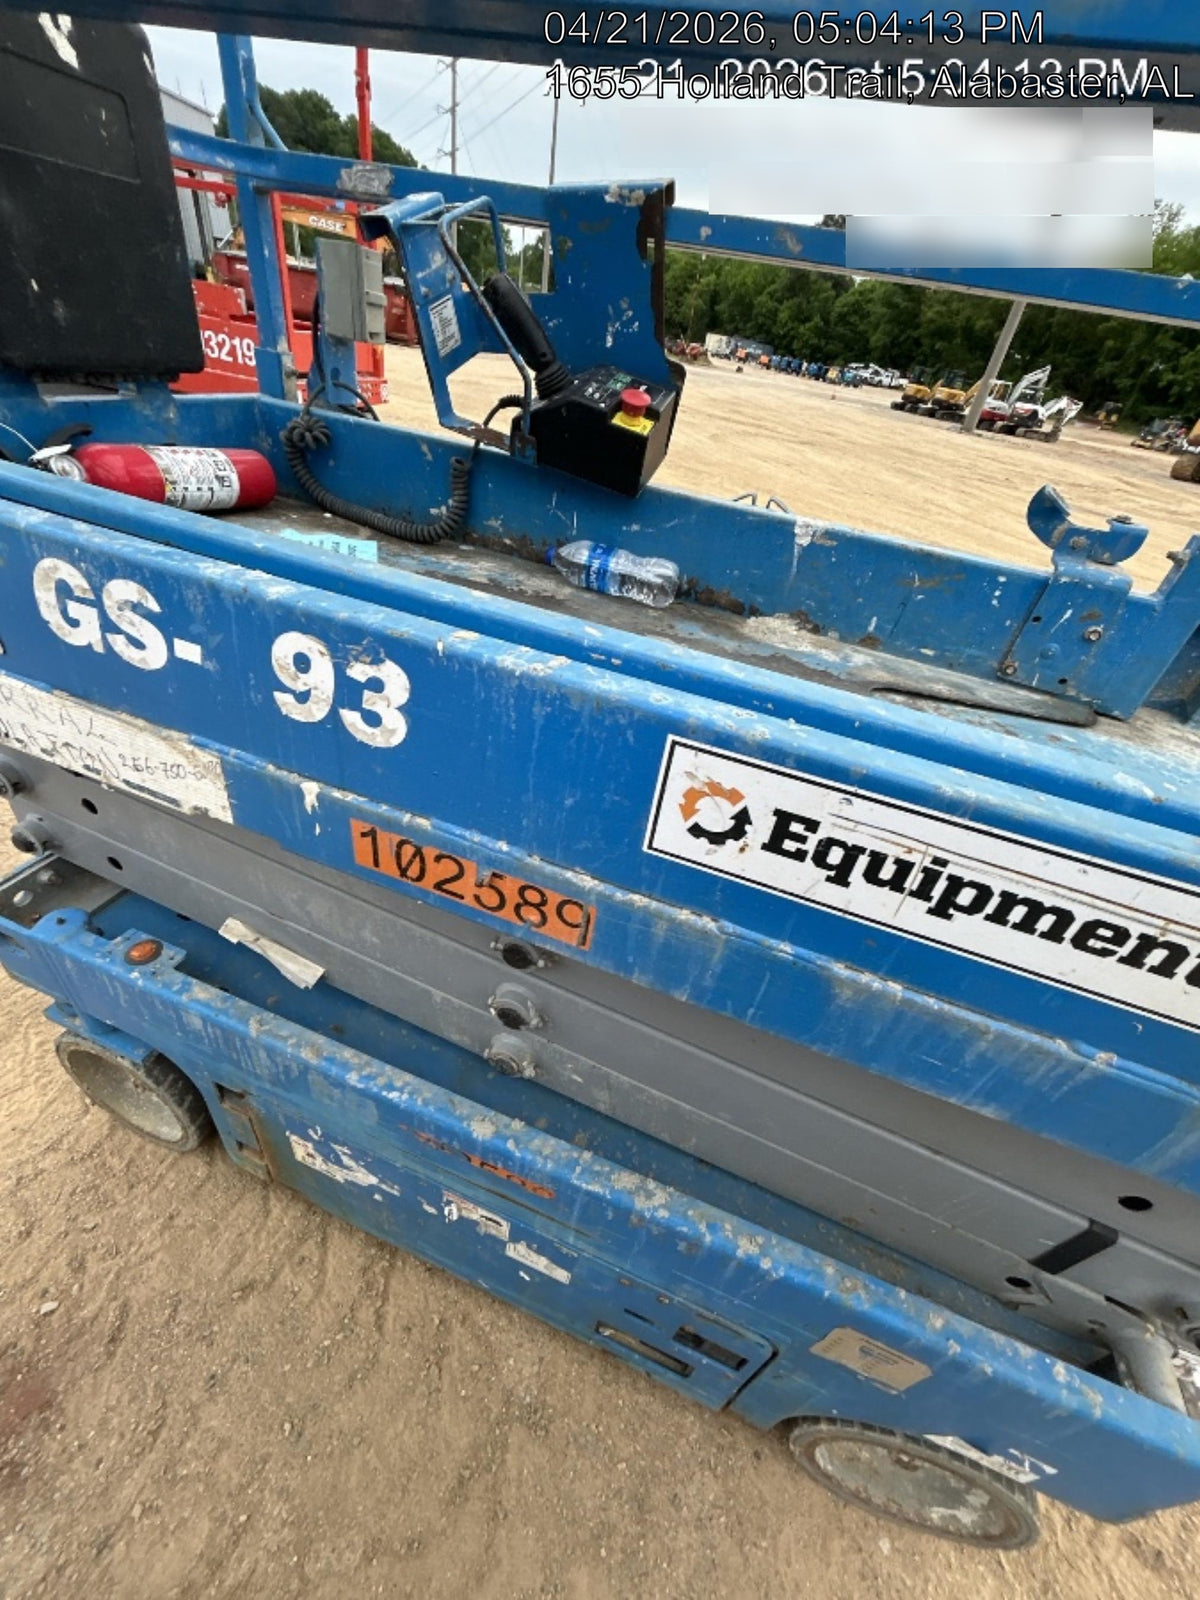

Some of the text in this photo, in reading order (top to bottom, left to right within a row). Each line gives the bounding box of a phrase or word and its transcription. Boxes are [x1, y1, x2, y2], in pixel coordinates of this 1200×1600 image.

[308, 215, 345, 232] CASE
[200, 329, 257, 366] 3219
[33, 557, 411, 748] GS- 93
[360, 826, 592, 947] 102589
